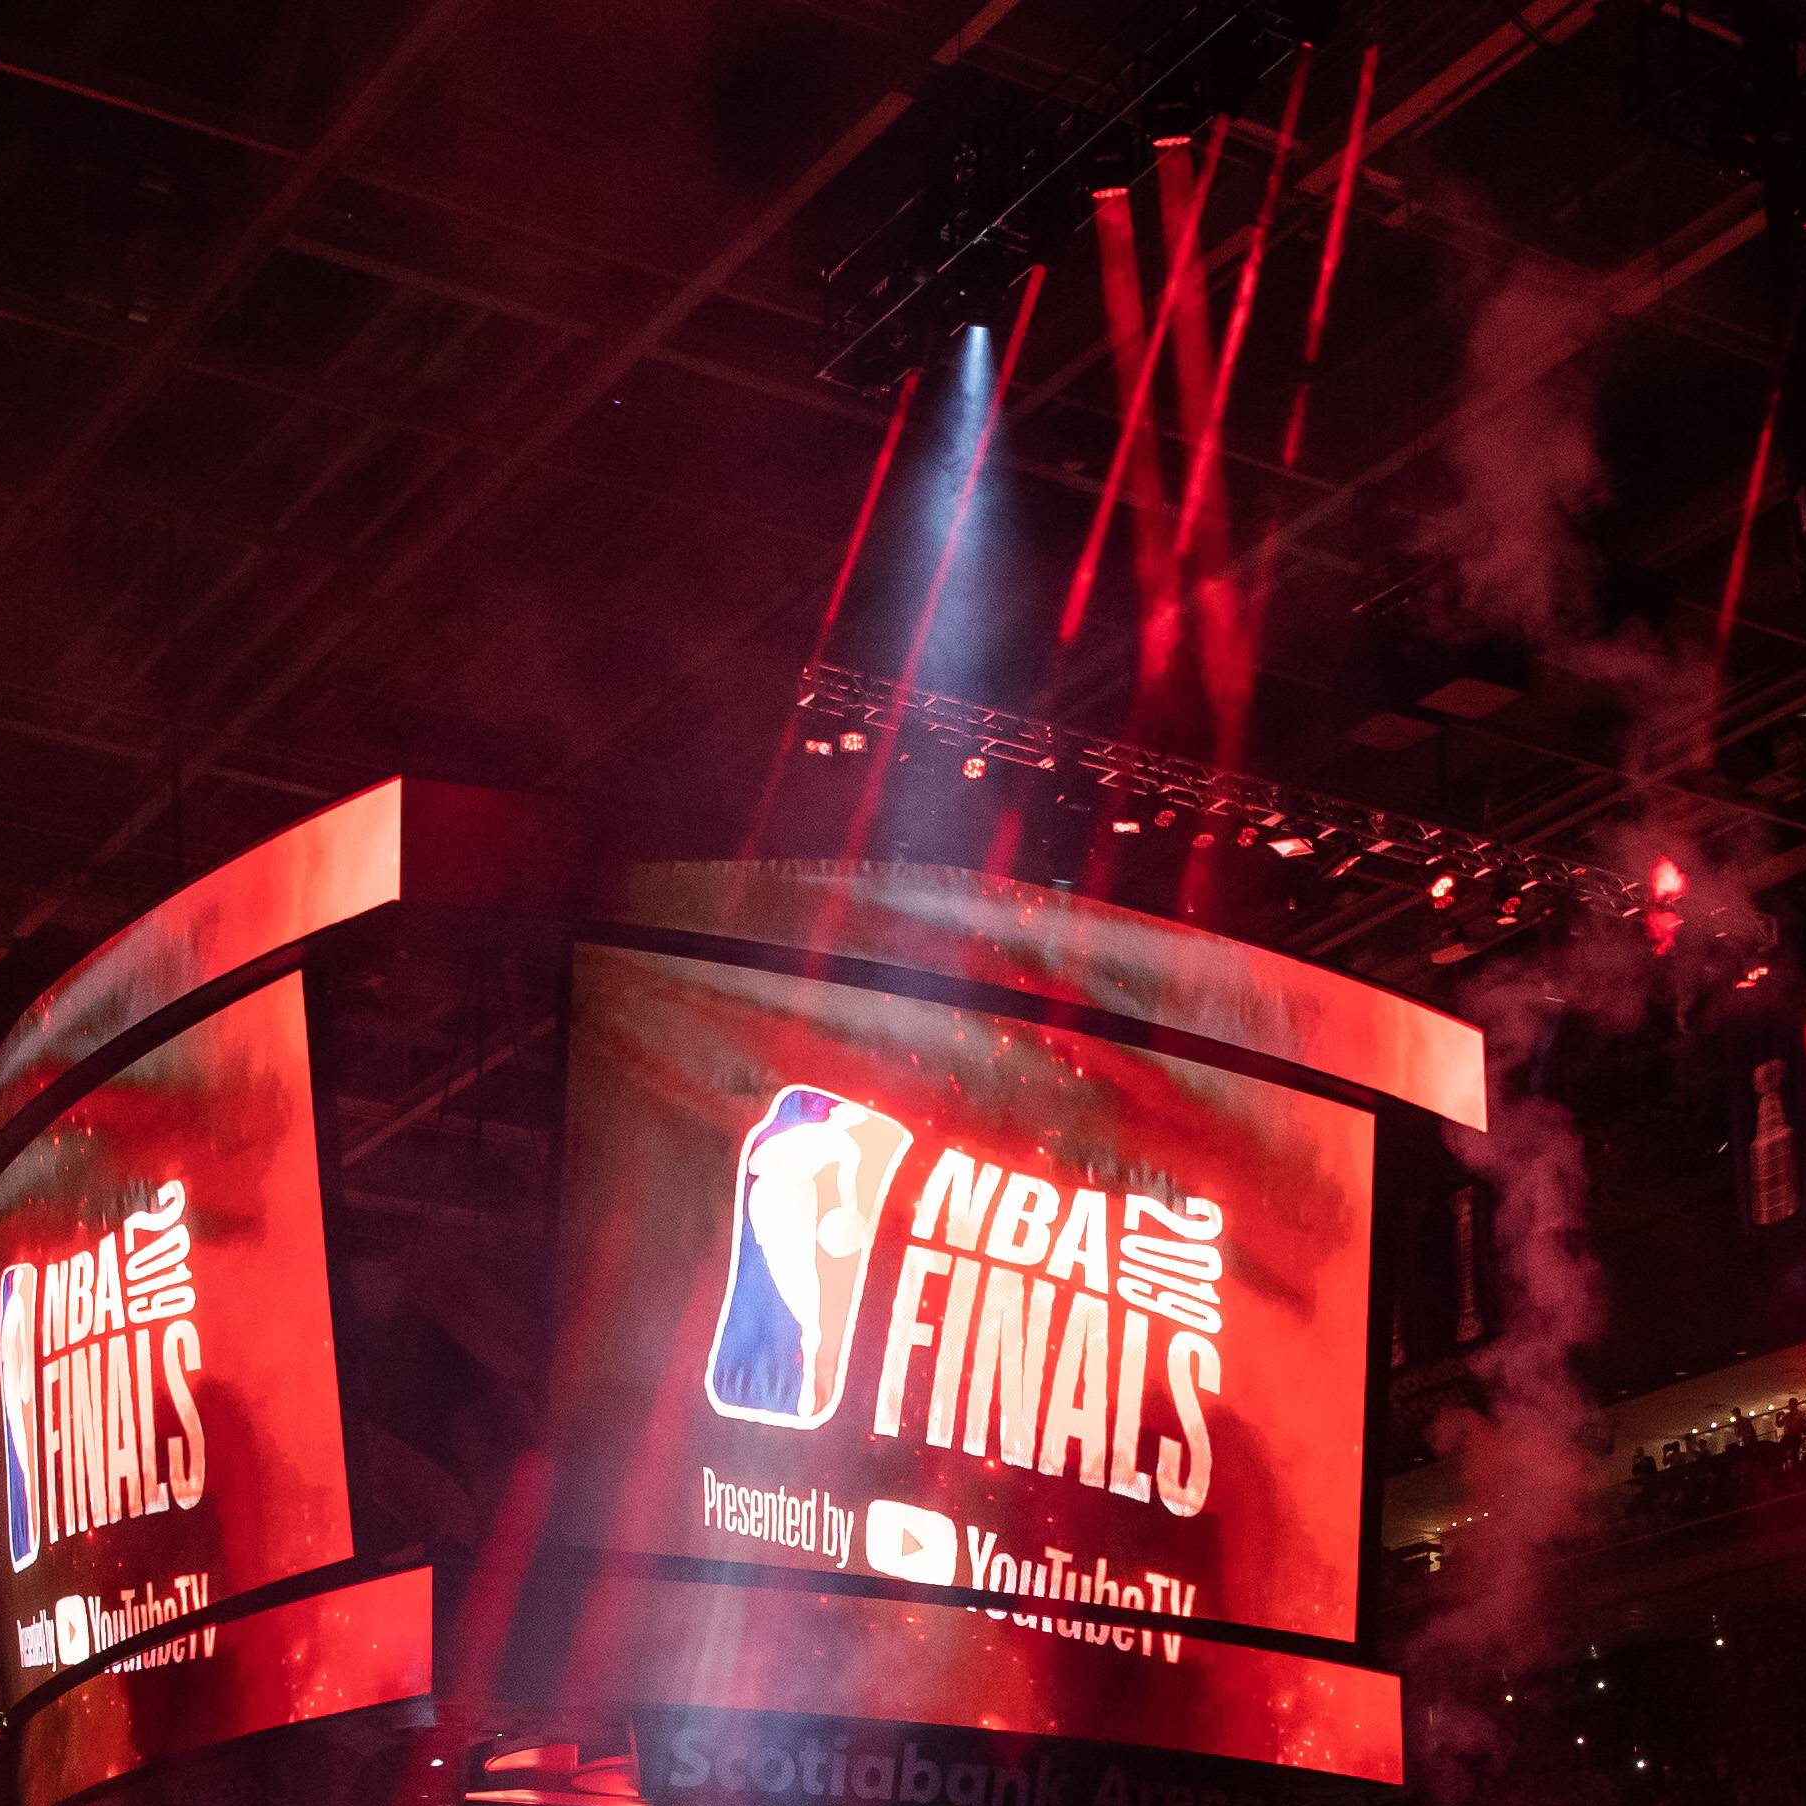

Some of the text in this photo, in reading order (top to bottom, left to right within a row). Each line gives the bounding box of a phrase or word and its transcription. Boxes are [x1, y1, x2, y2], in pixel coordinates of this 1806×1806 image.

[123, 1179, 197, 1323] 2019
[911, 1148, 1110, 1295] NBA
[1118, 1195, 1223, 1336] 2019
[42, 1231, 124, 1358] NBA
[42, 1319, 205, 1545] FINALS
[873, 1243, 1222, 1518] FINALS
[703, 1467, 817, 1551] Presented
[823, 1491, 855, 1569] by
